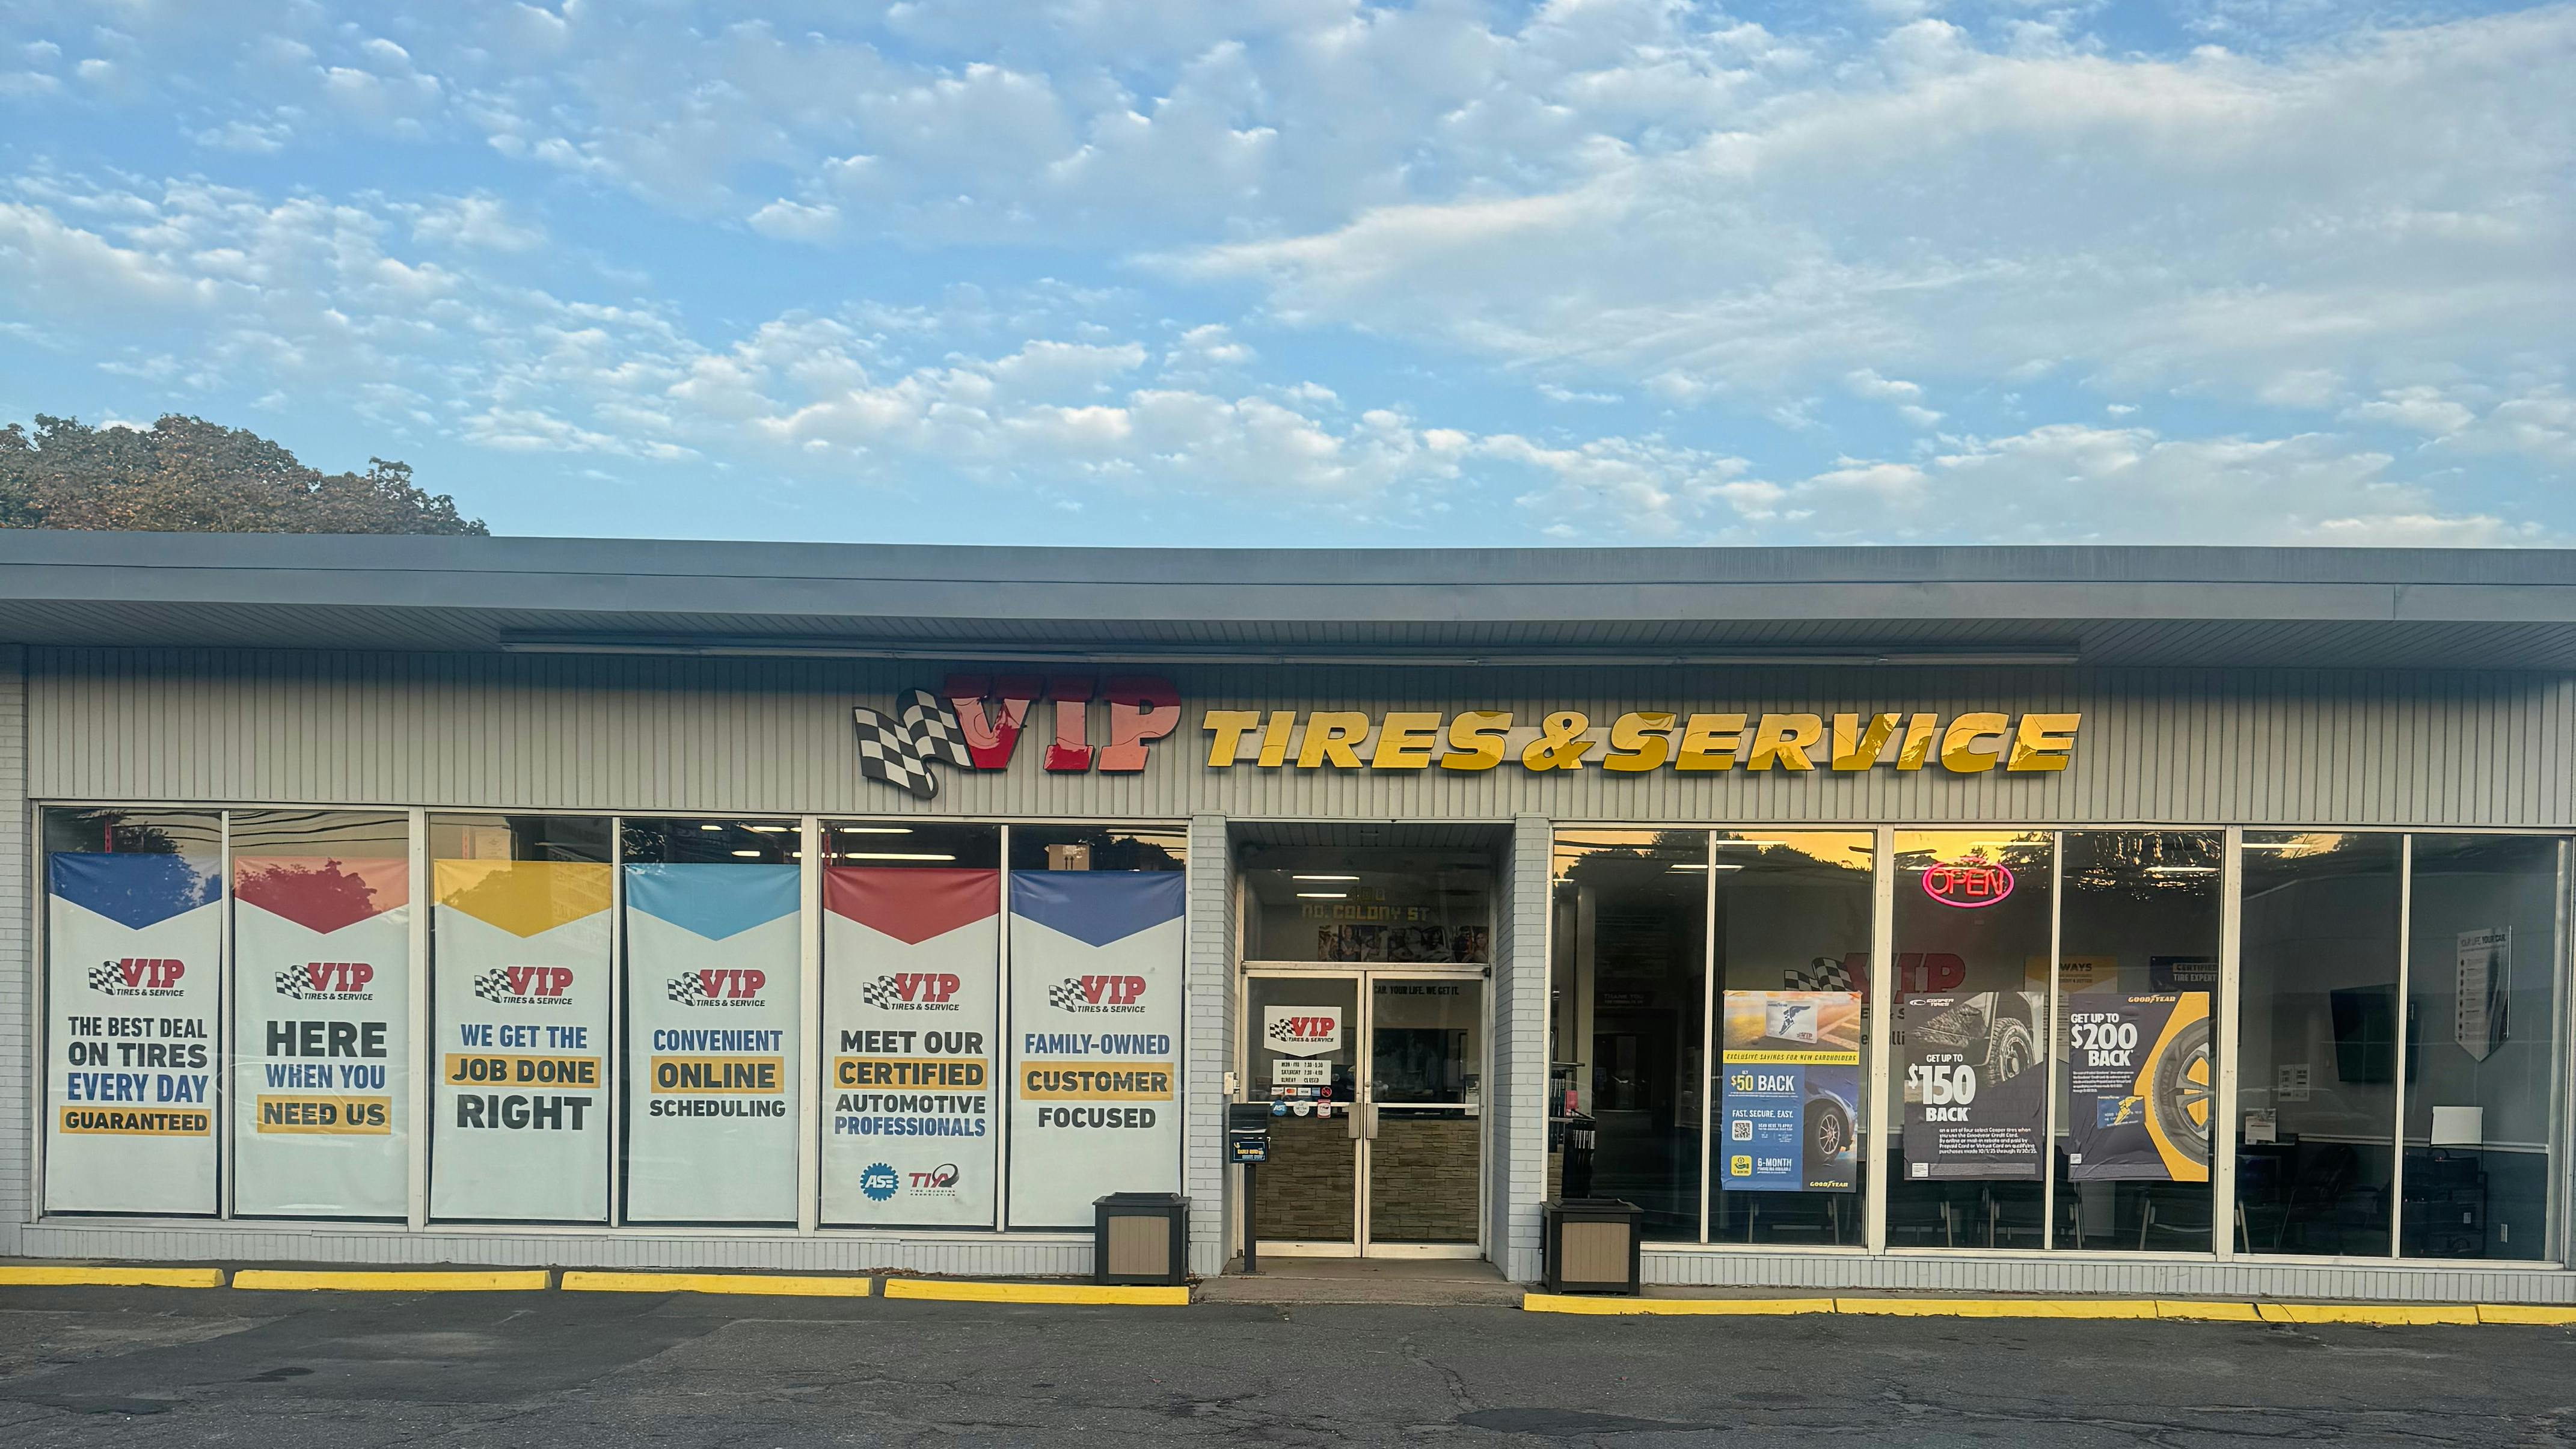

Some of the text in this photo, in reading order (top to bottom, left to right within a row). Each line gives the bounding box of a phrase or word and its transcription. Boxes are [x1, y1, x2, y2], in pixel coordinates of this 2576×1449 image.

[942, 674, 2081, 773] VIP TIRES & SERVICE
[1927, 868, 2004, 896] OPEN
[1407, 906, 1430, 921] ST
[121, 958, 185, 988] VIP
[308, 963, 373, 991] VIP
[507, 966, 574, 996] VIP
[700, 969, 765, 998] VIP
[895, 973, 960, 1002] VIP
[1081, 976, 1146, 1004] VIP
[1390, 986, 1408, 994] YOUR
[1426, 986, 1437, 994] WE
[1438, 986, 1450, 994] GET
[2128, 994, 2176, 1003] GOODYEAR
[68, 1016, 207, 1038] THE BEST DEAL
[1292, 1017, 1335, 1037] VIP
[2071, 1013, 2120, 1023] GET UP TO
[266, 1021, 387, 1058] HERE
[461, 1024, 587, 1049] WE GET THE
[654, 1029, 783, 1052] CONVENIENT
[841, 1030, 983, 1054] MEET OUR
[1025, 1034, 1170, 1055] FAMILY-OWNED
[2071, 1023, 2138, 1050] $200
[69, 1041, 207, 1068] ON TIRES
[266, 1064, 385, 1089] WHEN YOU
[452, 1058, 595, 1083] JOB DONE
[658, 1062, 775, 1088] ONLINE
[839, 1062, 984, 1086] CERTIFIED
[1027, 1071, 1167, 1092] CUSTOMER
[68, 1073, 209, 1103] EVERY DAY
[1731, 1075, 1794, 1091] $50 BACK
[1908, 1064, 1976, 1105] $150
[265, 1103, 385, 1126] NEED US
[457, 1094, 592, 1130] RIGHT
[649, 1099, 785, 1117] SCHEDULING
[835, 1094, 986, 1114] AUTOMOTIVE
[66, 1112, 207, 1131] GUARANTEED
[835, 1116, 986, 1137] PROFESSIONALS
[1038, 1107, 1156, 1129] FOCUSED
[1758, 1157, 1792, 1167] 6-MONTH
[865, 1175, 894, 1189] ASE
[909, 1173, 950, 1188] TIA
